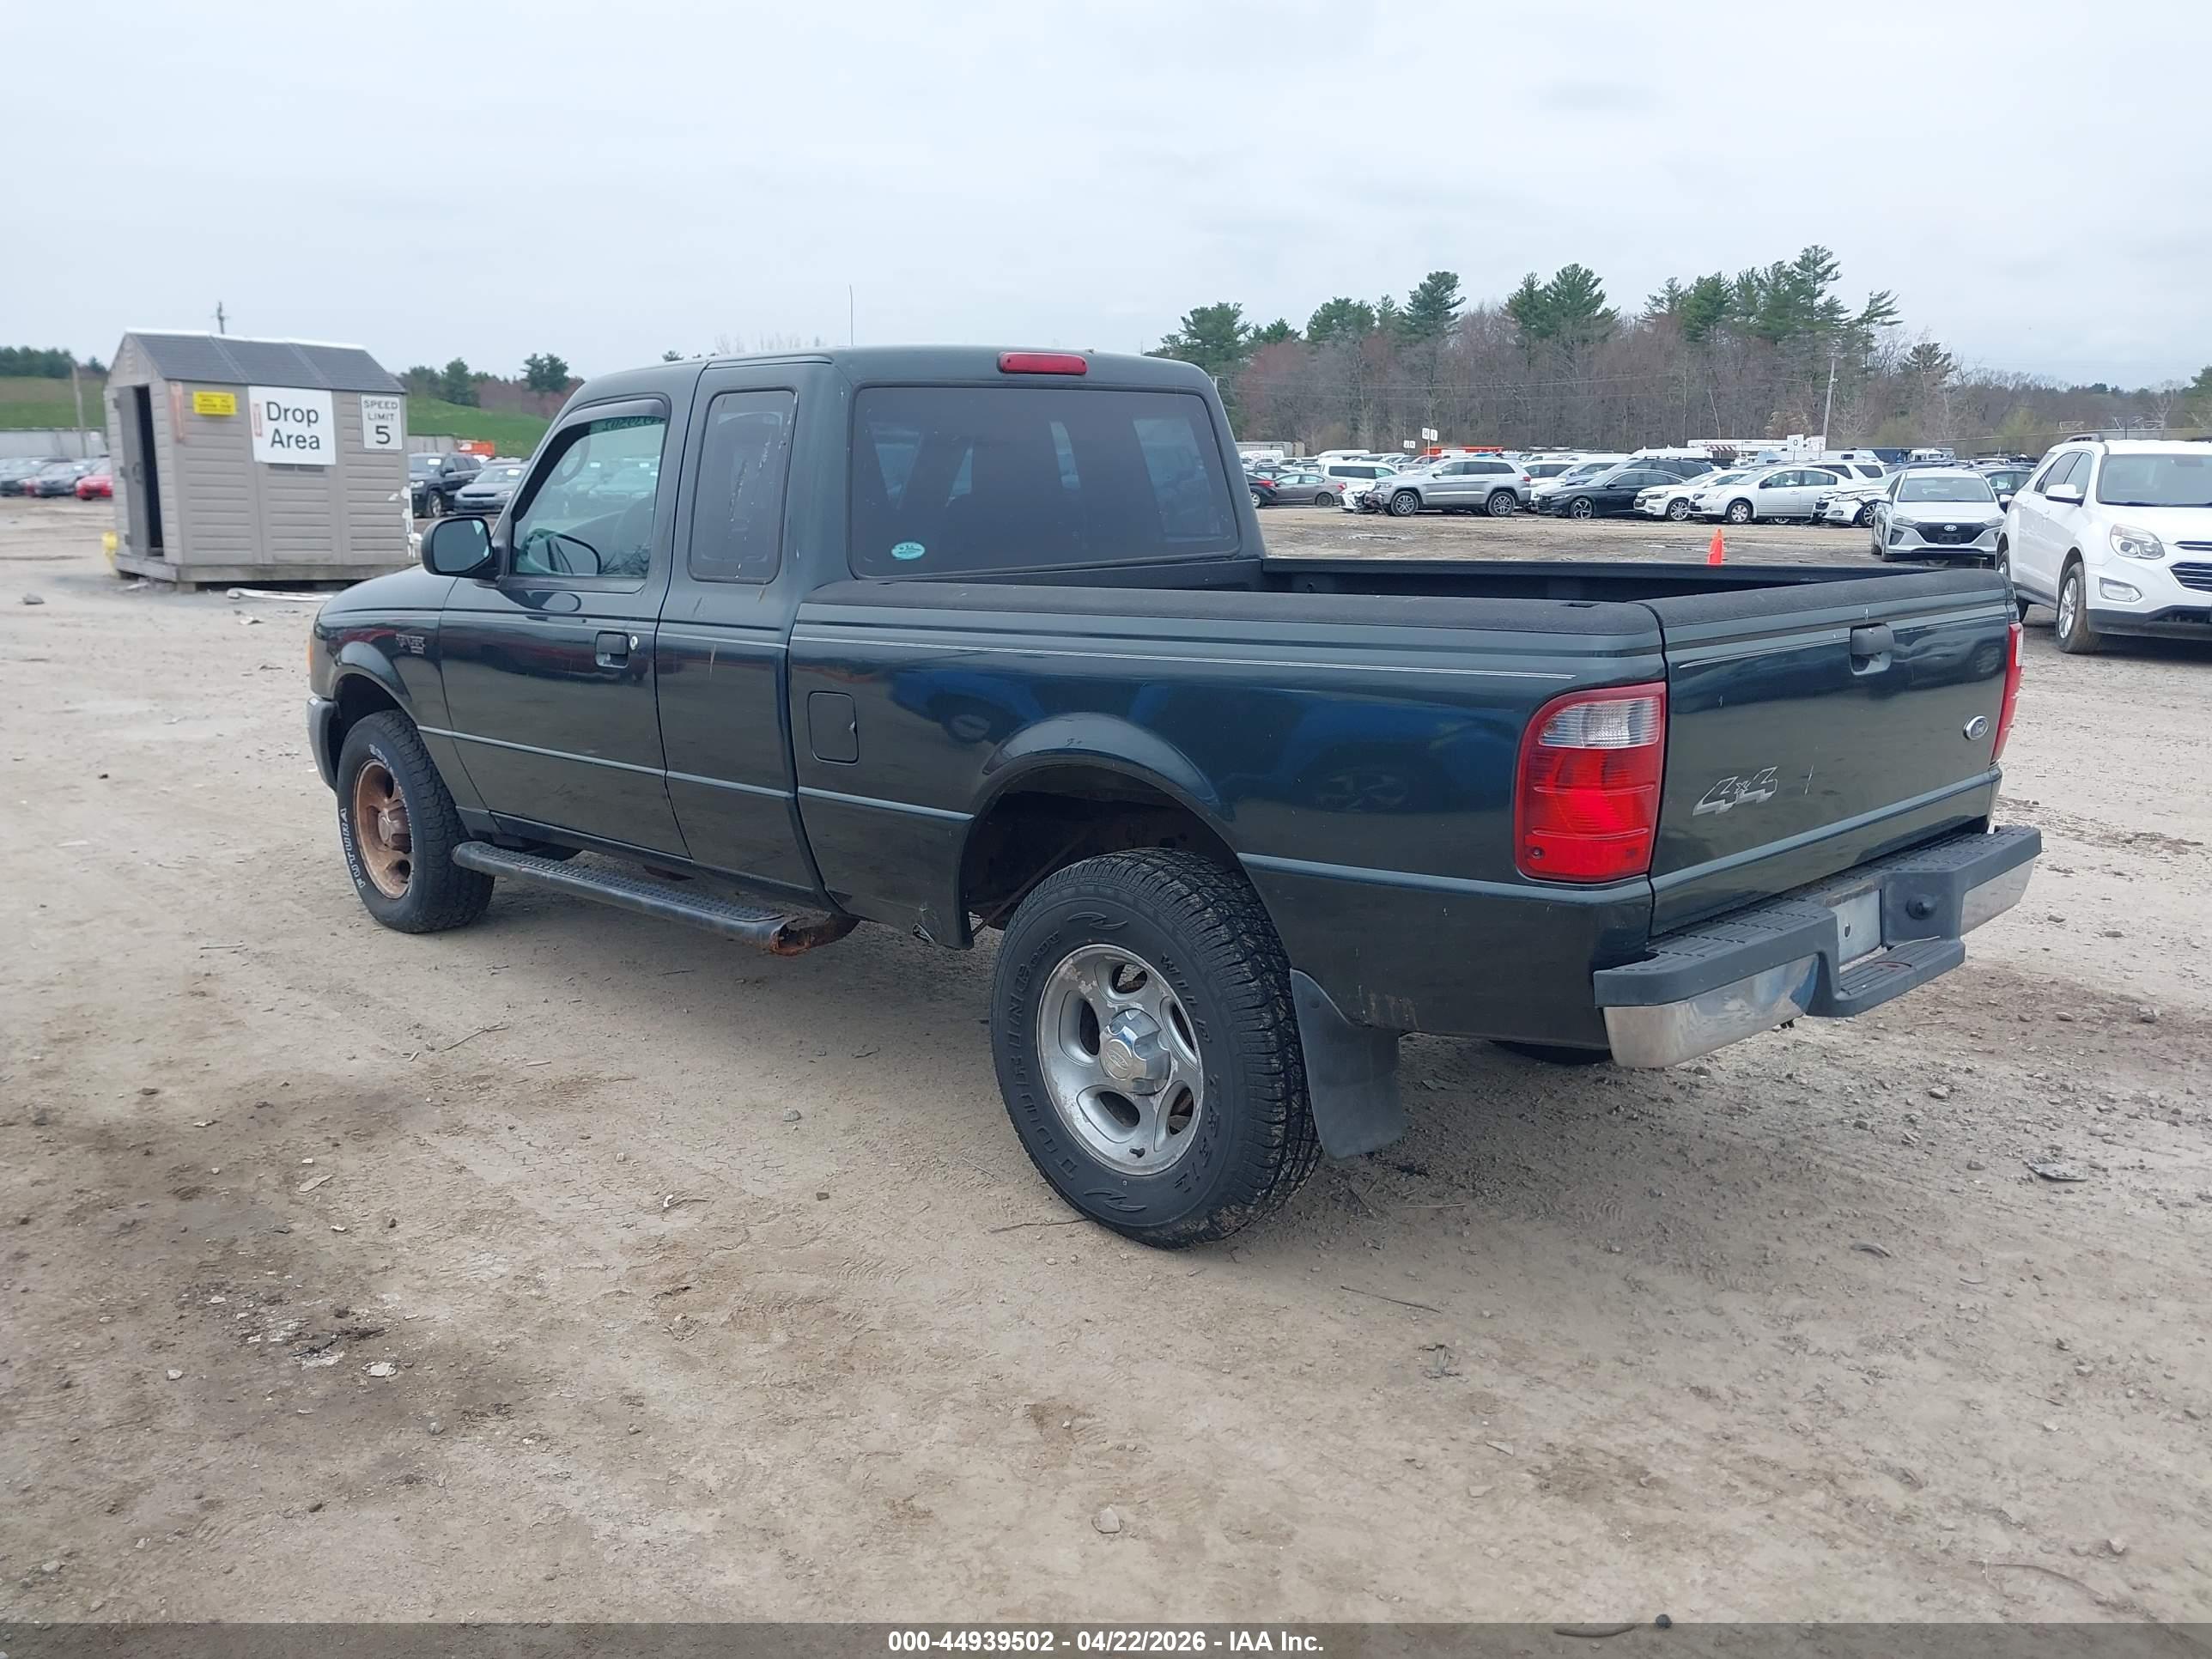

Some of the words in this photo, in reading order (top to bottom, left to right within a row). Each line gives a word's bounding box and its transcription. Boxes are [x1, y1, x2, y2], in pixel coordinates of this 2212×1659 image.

[266, 401, 319, 428] Drop
[363, 398, 399, 410] SPEED
[368, 412, 394, 421] LIMIT
[270, 428, 320, 450] Area
[375, 425, 392, 445] 5
[1691, 766, 1778, 817] 4x4
[339, 806, 367, 890] FUTURA
[1160, 952, 1212, 1045] WILD
